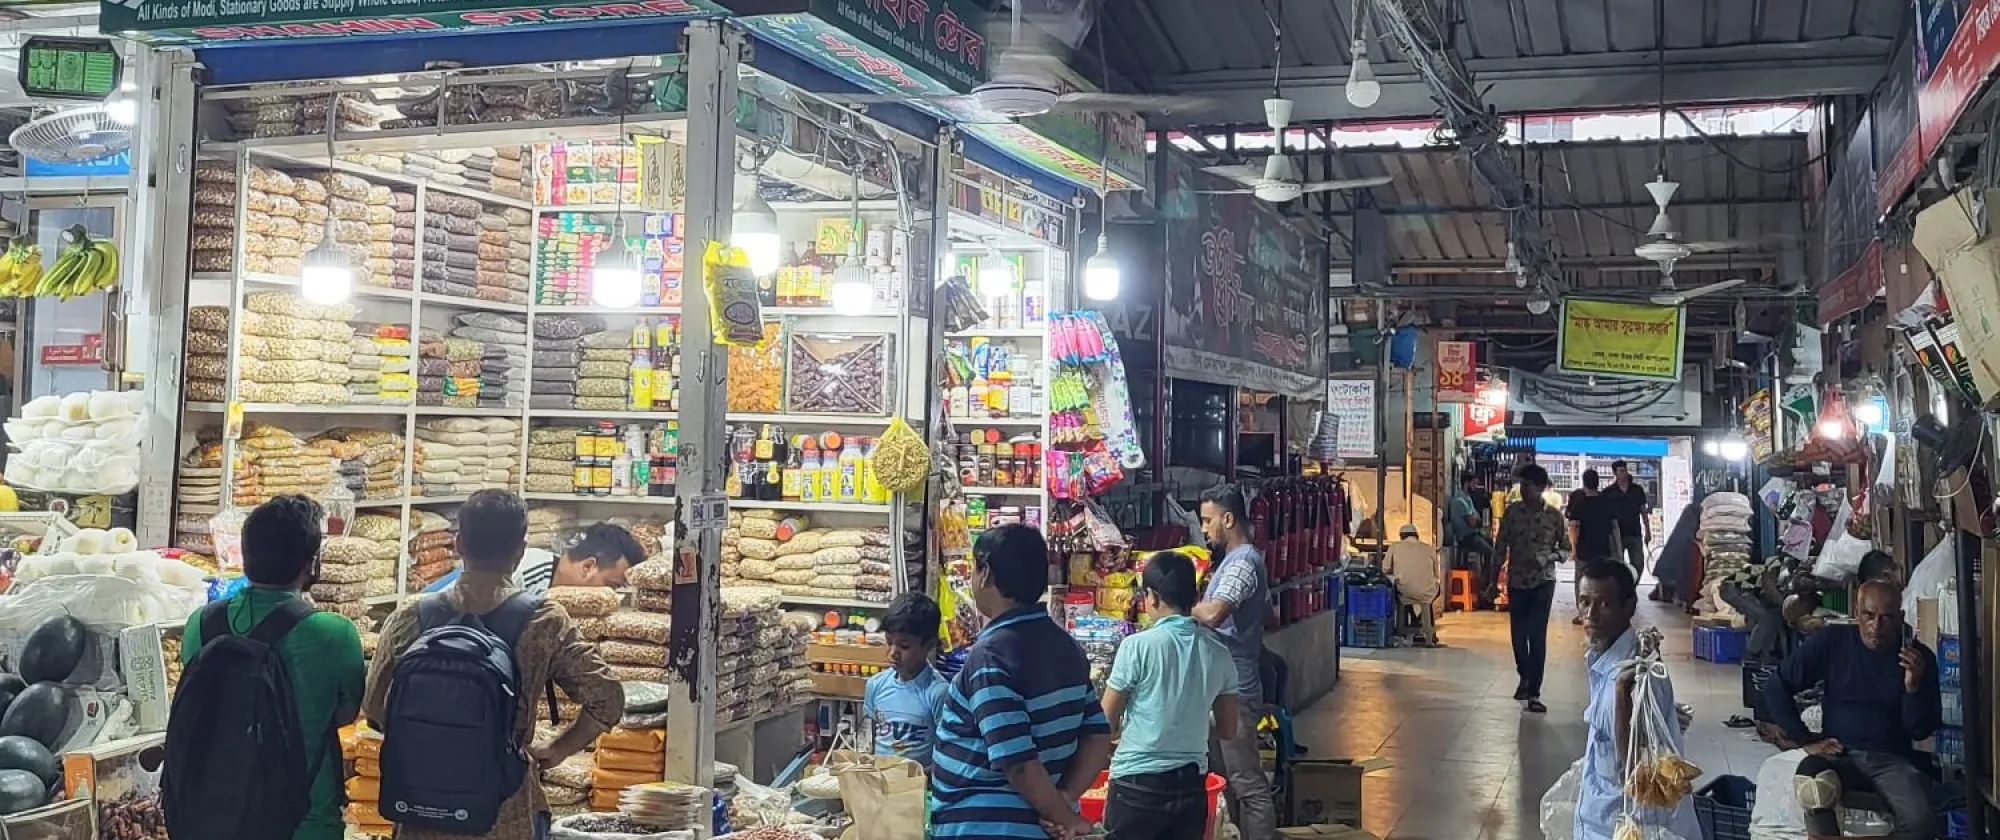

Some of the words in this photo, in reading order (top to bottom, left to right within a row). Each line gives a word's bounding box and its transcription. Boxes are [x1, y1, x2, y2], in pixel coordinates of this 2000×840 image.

[137, 4, 150, 20] All
[152, 3, 179, 18] Kinds
[180, 3, 191, 17] of
[192, 1, 218, 17] Modi,
[220, 0, 267, 17] Stationary
[269, 0, 301, 12] Goods
[303, 0, 320, 10] are
[460, 0, 699, 26] STORE
